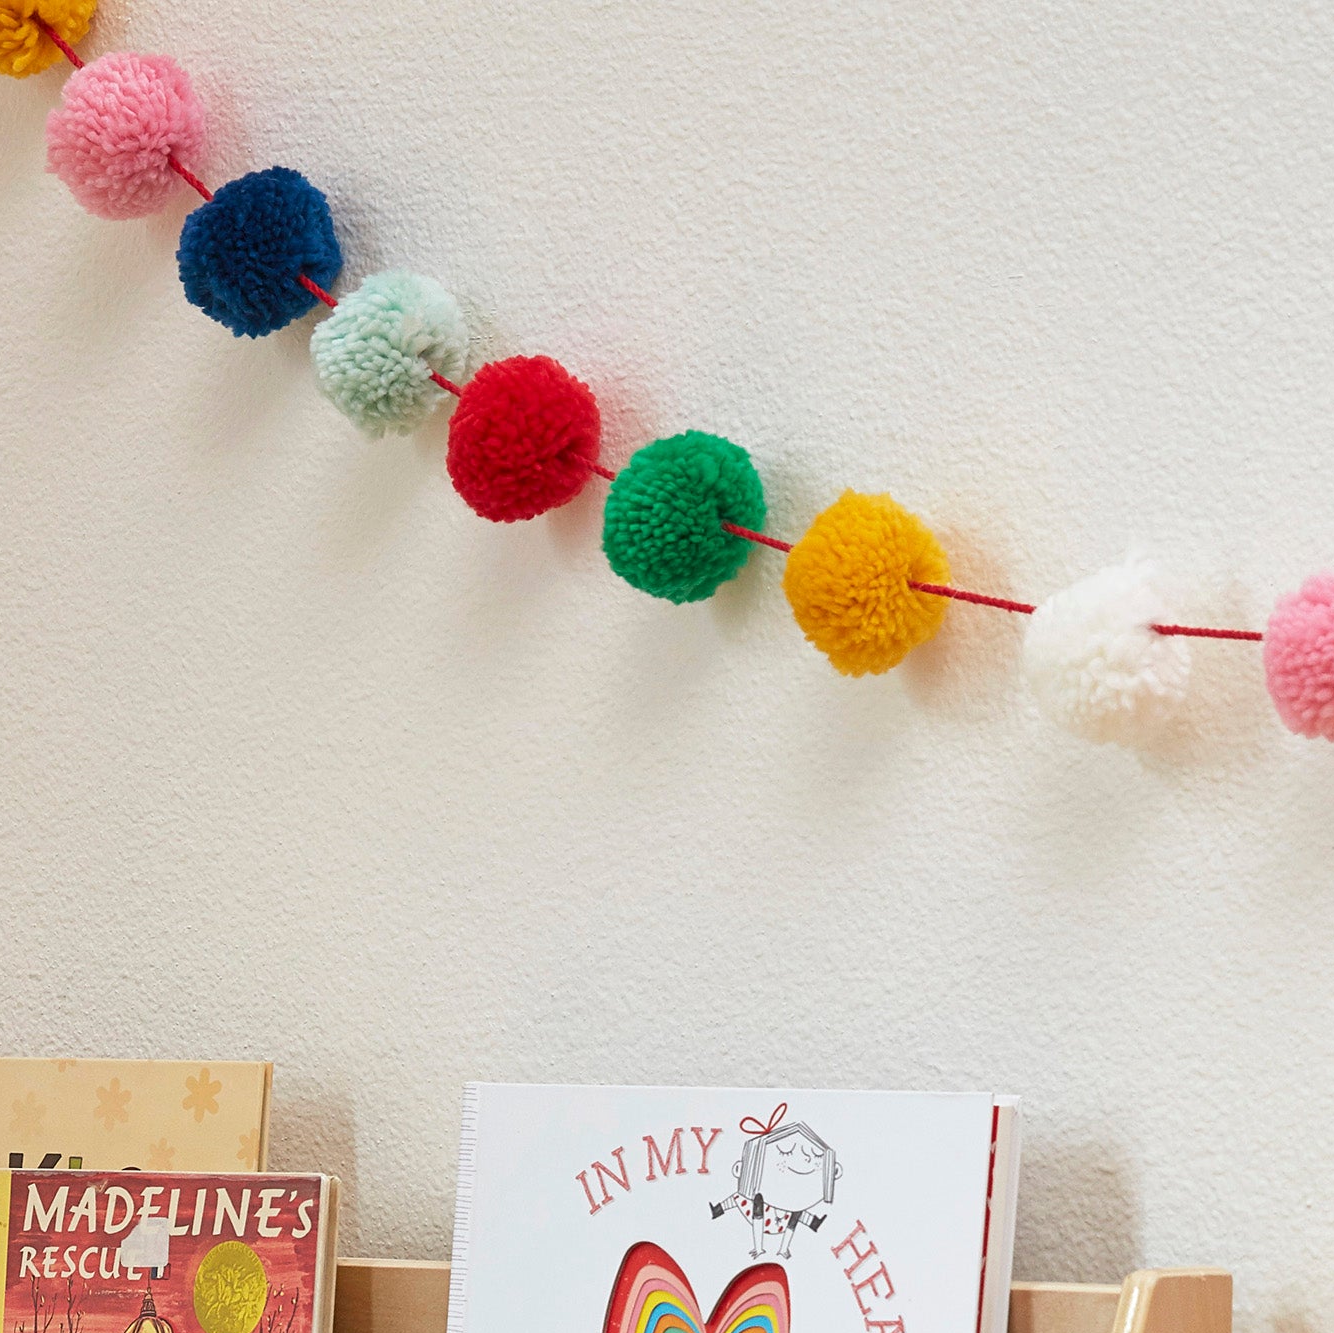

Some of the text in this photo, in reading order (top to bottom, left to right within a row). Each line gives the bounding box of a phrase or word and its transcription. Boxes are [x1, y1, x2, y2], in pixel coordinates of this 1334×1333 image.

[574, 1146, 633, 1216] IN
[641, 1126, 723, 1182] MY
[19, 1246, 144, 1280] RESCU
